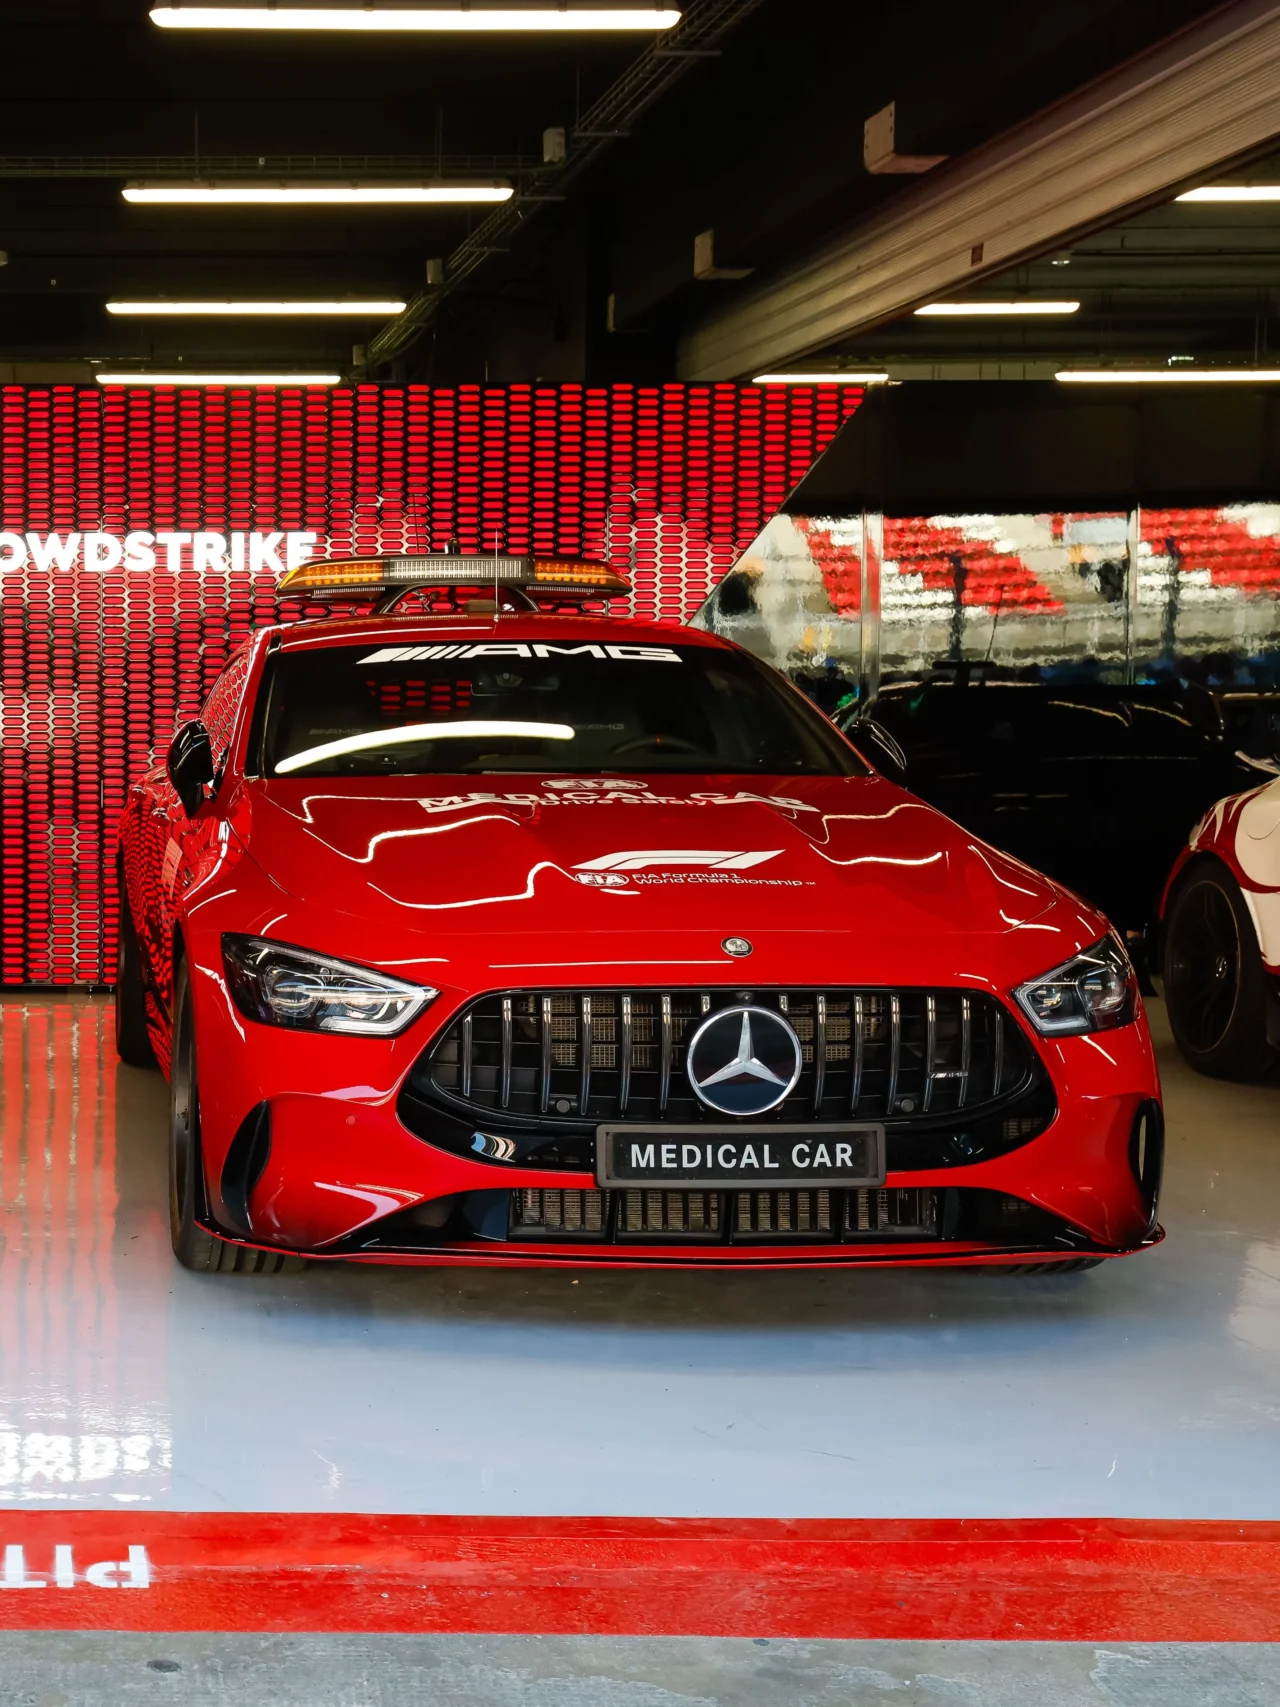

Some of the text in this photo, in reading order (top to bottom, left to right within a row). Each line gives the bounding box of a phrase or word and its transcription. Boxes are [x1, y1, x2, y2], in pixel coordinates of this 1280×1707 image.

[459, 644, 683, 662] AMG
[417, 791, 677, 809] MEDICAL
[579, 874, 625, 885] FIA
[687, 877, 803, 887] Championship
[630, 1143, 854, 1169] MEDICAL CAR
